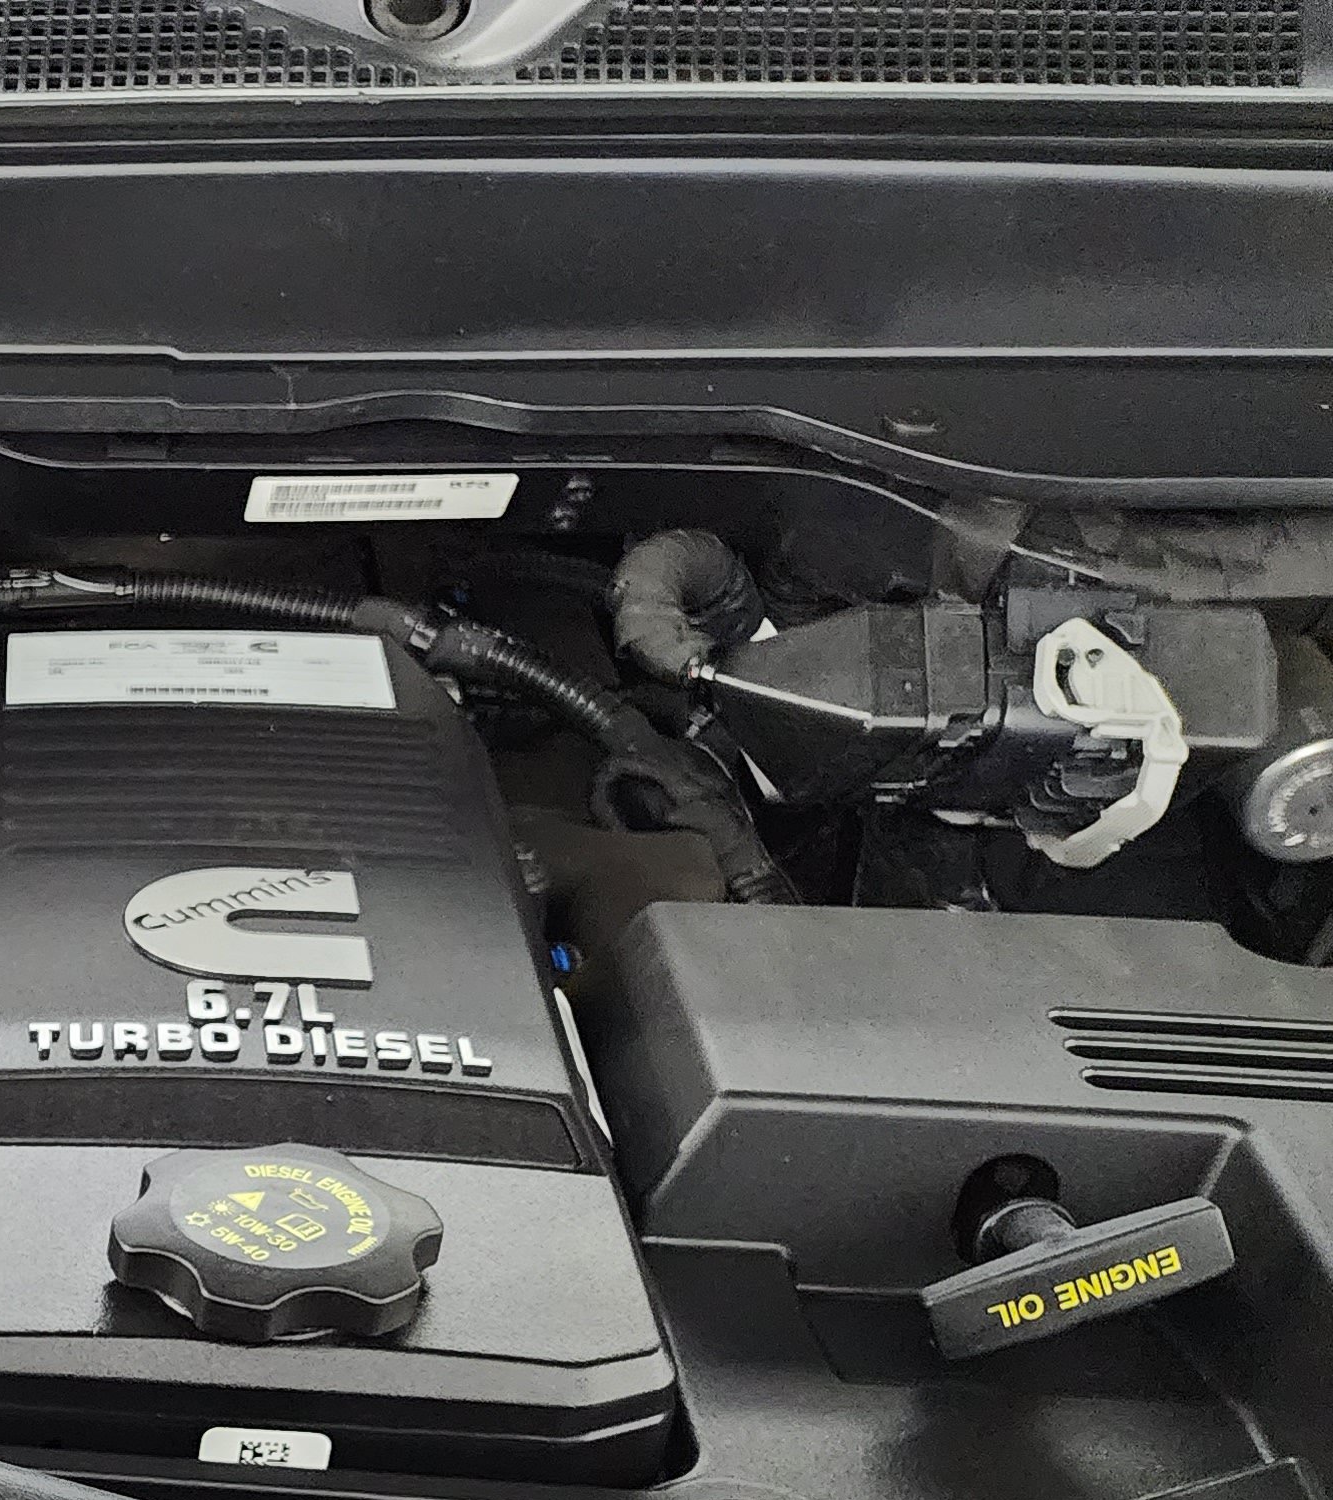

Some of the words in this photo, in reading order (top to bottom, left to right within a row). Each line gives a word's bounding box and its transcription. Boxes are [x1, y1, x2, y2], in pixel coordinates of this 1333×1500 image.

[132, 874, 333, 930] Cummins
[186, 979, 336, 1030] 6.7L
[28, 1021, 242, 1061] TURBO
[262, 1024, 493, 1076] DIESEL
[244, 1164, 315, 1184] DIESEL
[315, 1176, 373, 1217] ENGINE
[346, 1216, 375, 1235] OIL
[209, 1226, 271, 1262] 5W-40
[233, 1213, 298, 1252] 10W-30
[1053, 1245, 1183, 1311] ENGINE
[986, 1293, 1045, 1329] OIL
